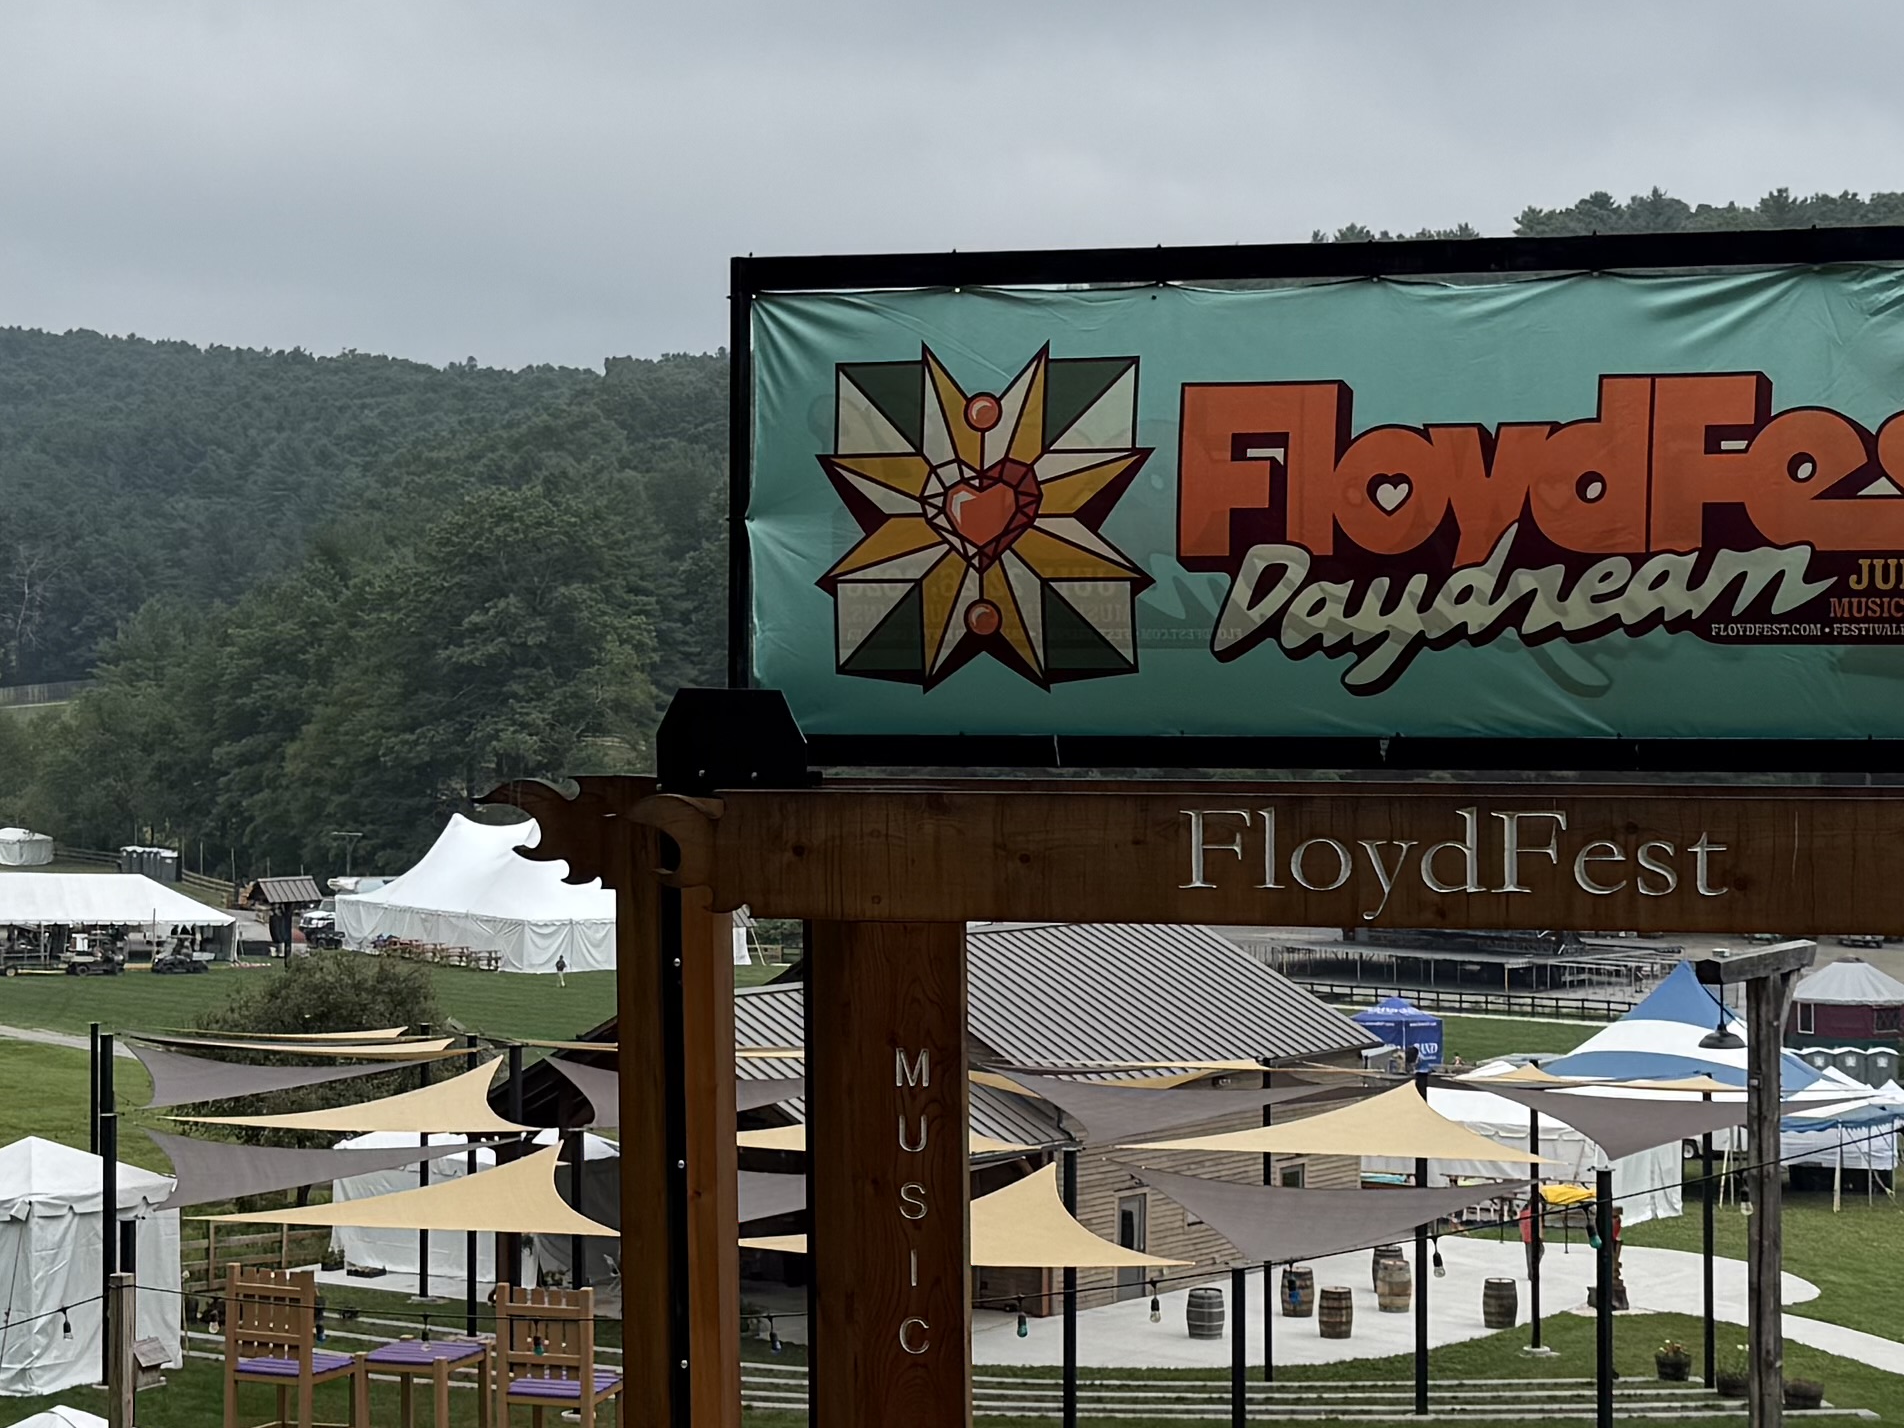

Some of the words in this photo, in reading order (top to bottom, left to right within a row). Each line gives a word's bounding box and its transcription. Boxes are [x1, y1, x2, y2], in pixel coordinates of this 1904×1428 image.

[1213, 524, 1838, 684] Daydream
[1711, 623, 1821, 636] FLOYDFEST.COM
[1178, 806, 1730, 920] FloydFest
[895, 1047, 930, 1355] MUSIC
